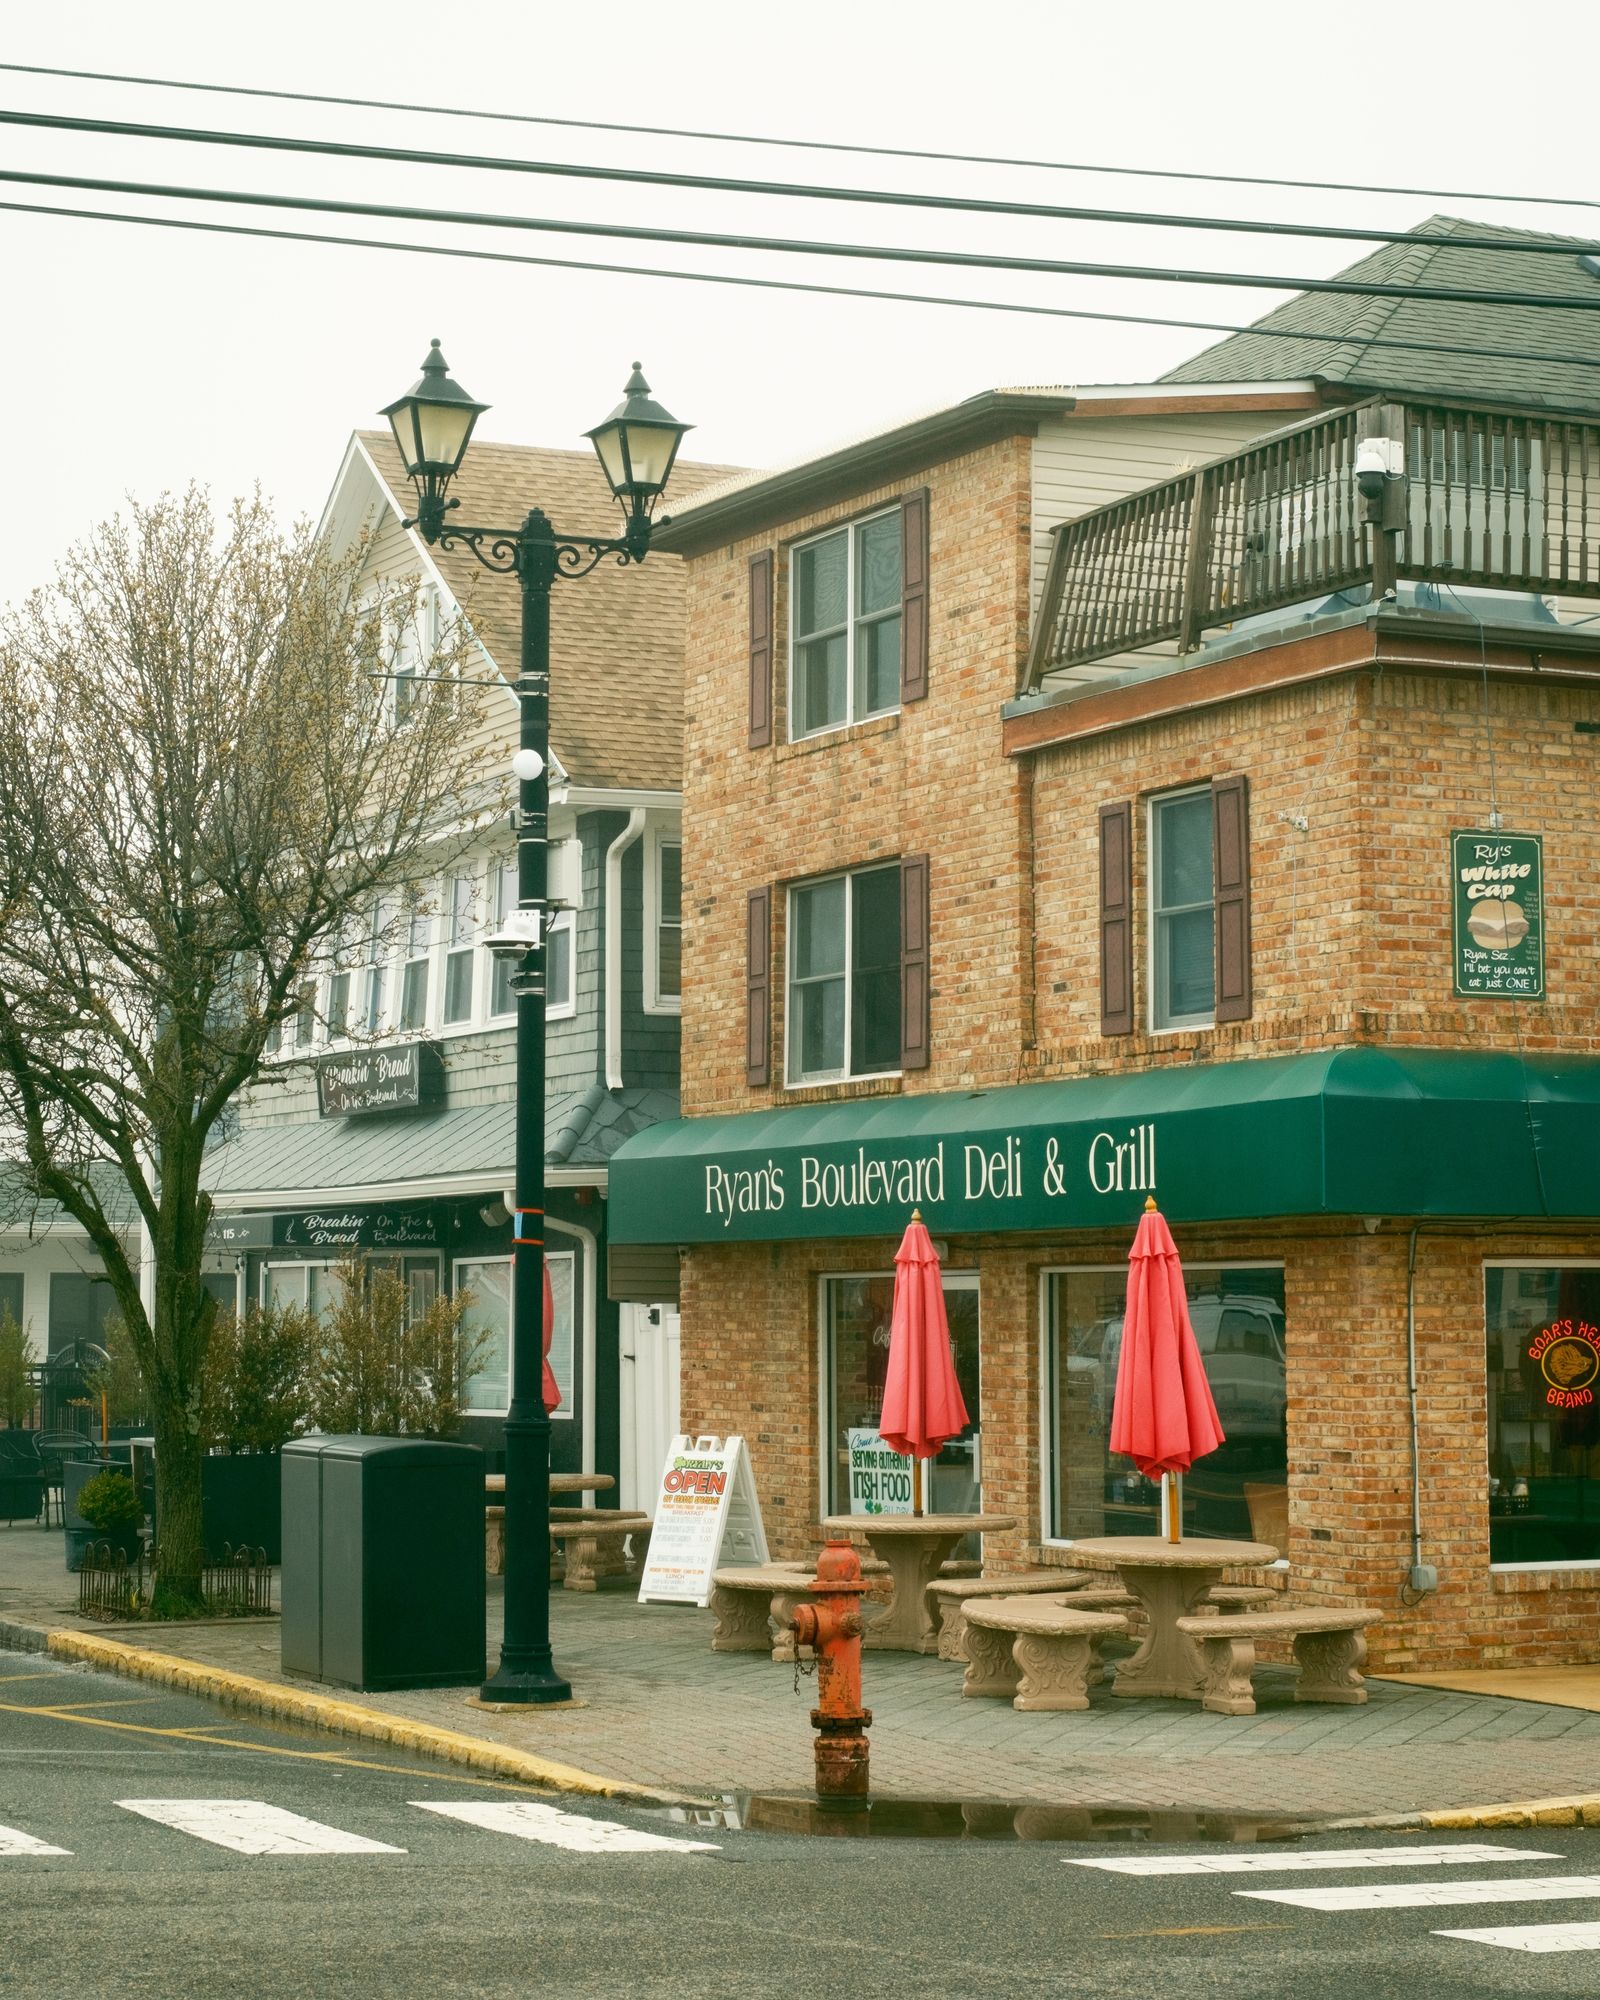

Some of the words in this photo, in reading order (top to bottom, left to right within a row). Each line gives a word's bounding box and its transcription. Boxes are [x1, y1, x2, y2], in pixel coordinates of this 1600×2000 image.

[1473, 845, 1512, 865] Ry's
[1461, 863, 1531, 883] White
[1467, 883, 1516, 900] Cap
[1463, 949, 1488, 964] Ryan
[1478, 963, 1491, 974] bet
[1494, 967, 1510, 978] you
[1514, 966, 1536, 976] can't
[1469, 978, 1482, 987] eat
[1486, 978, 1503, 990] just
[375, 1050, 412, 1083] Bread
[341, 1093, 351, 1111] On
[705, 1159, 785, 1227] Ryan's
[801, 1141, 945, 1209] Boulevard
[964, 1135, 1023, 1200] Deli
[1043, 1137, 1067, 1197] &
[1089, 1123, 1157, 1194] Grill
[303, 1215, 369, 1229] Breakin'
[377, 1215, 394, 1227] On
[223, 1228, 235, 1240] 115
[310, 1230, 359, 1245] Bread
[1528, 1319, 1573, 1360] BOAR'S
[1546, 1387, 1593, 1409] BRAND
[664, 1469, 727, 1495] OPEN
[881, 1472, 911, 1502] FOOD
